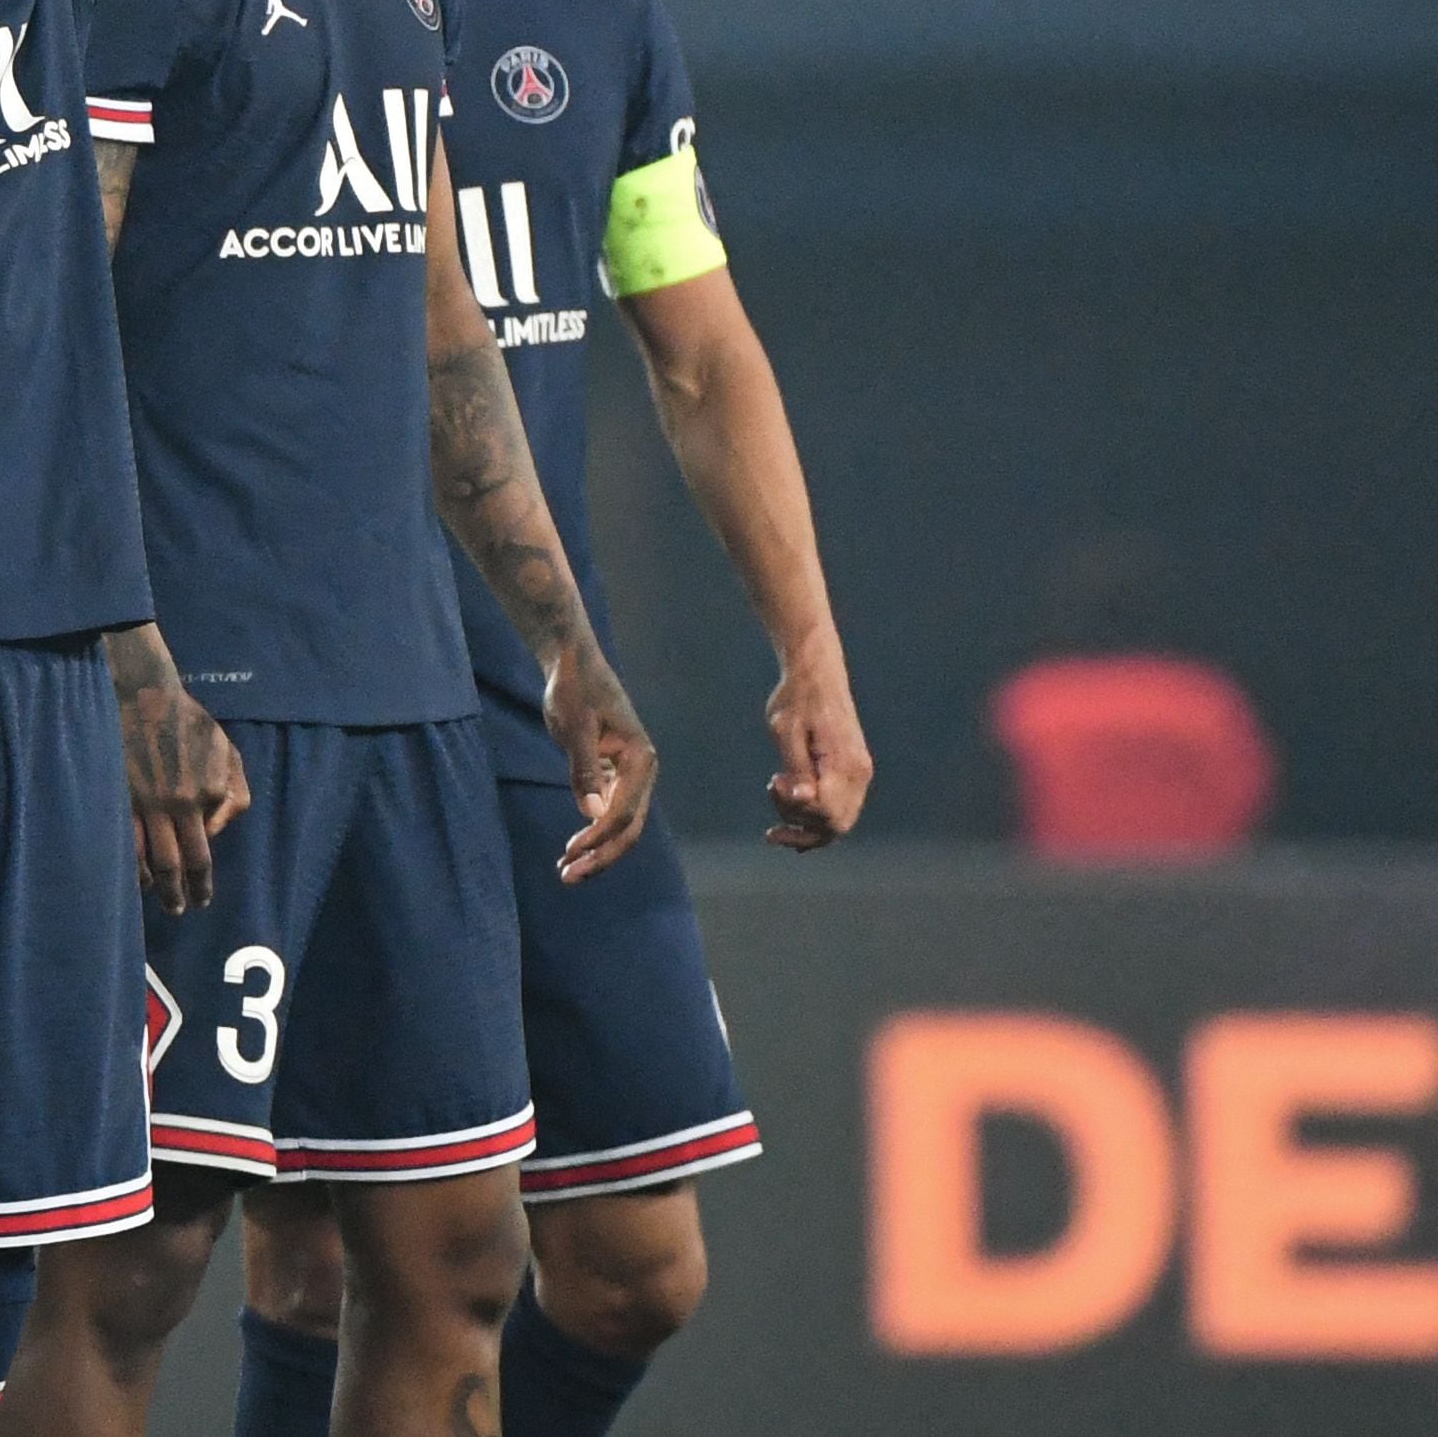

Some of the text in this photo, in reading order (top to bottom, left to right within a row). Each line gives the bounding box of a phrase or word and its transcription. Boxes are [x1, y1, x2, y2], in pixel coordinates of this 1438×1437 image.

[219, 226, 334, 259] ACCOR
[337, 223, 402, 257] LIVE
[216, 945, 285, 1085] 3
